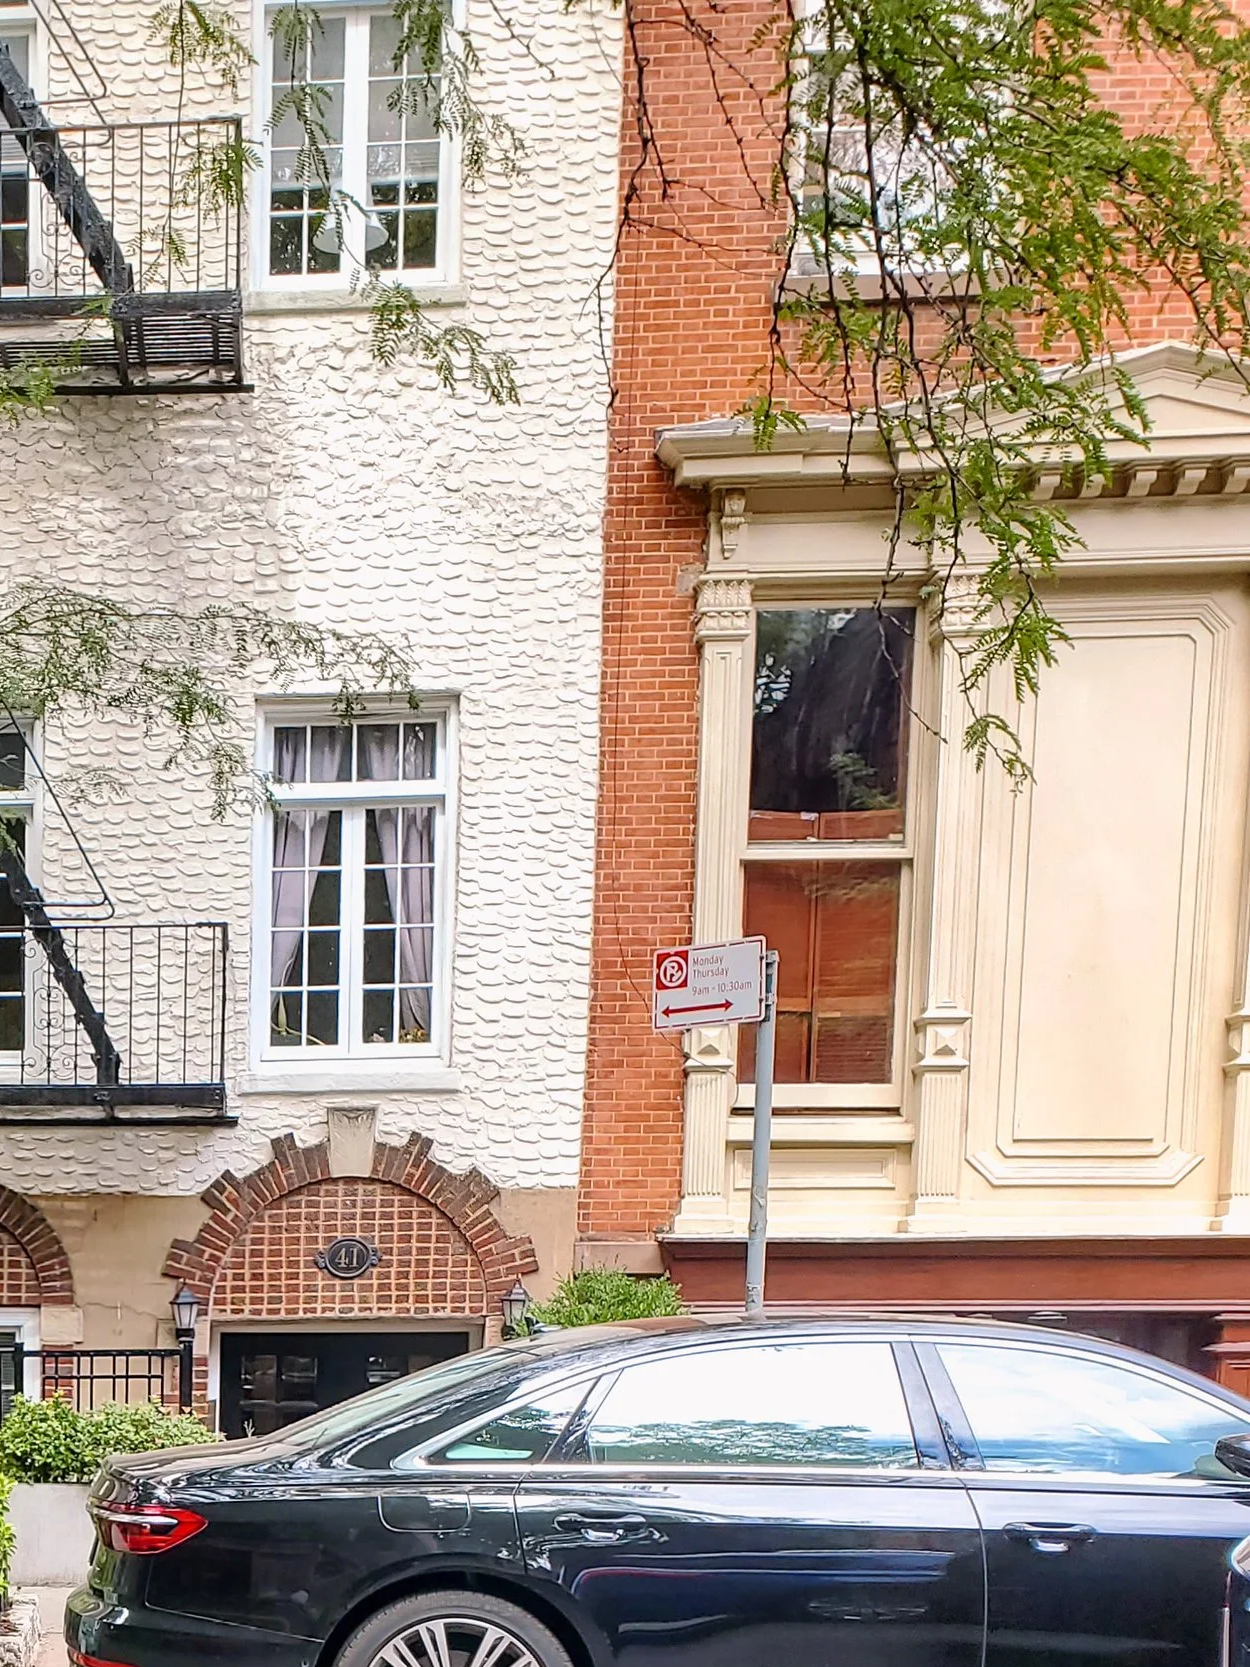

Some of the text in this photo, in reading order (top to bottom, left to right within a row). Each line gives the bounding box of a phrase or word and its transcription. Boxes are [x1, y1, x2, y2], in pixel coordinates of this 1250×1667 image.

[692, 955, 724, 966] Monday
[693, 967, 729, 978] Thursday
[692, 986, 710, 996] 9am
[717, 980, 752, 993] 10:30am
[335, 1247, 360, 1268] 41
